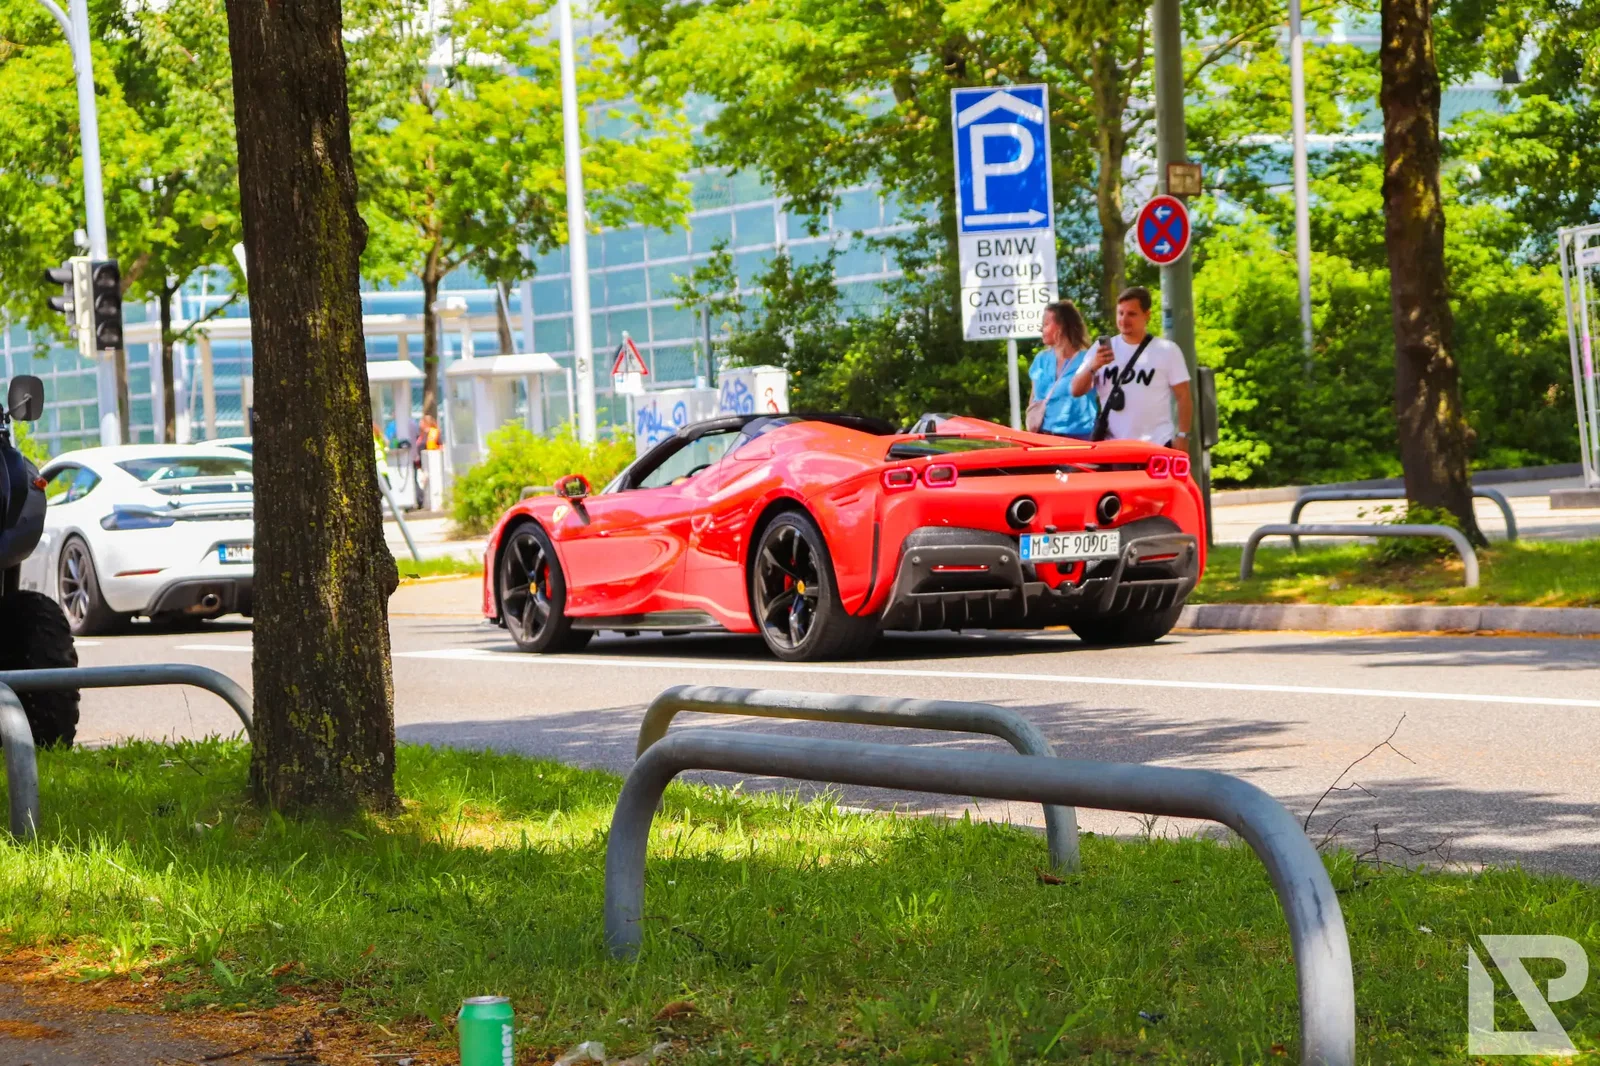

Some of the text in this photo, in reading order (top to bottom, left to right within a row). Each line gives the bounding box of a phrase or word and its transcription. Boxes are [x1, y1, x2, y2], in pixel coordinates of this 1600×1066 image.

[970, 123, 1035, 211] P
[977, 237, 1036, 257] BMW
[975, 261, 1042, 281] Group
[969, 287, 1051, 308] CACEIS
[979, 309, 1041, 322] investor
[980, 323, 1043, 335] services
[1031, 537, 1041, 556] M
[1052, 536, 1070, 555] SF
[1074, 534, 1108, 554] 9090
